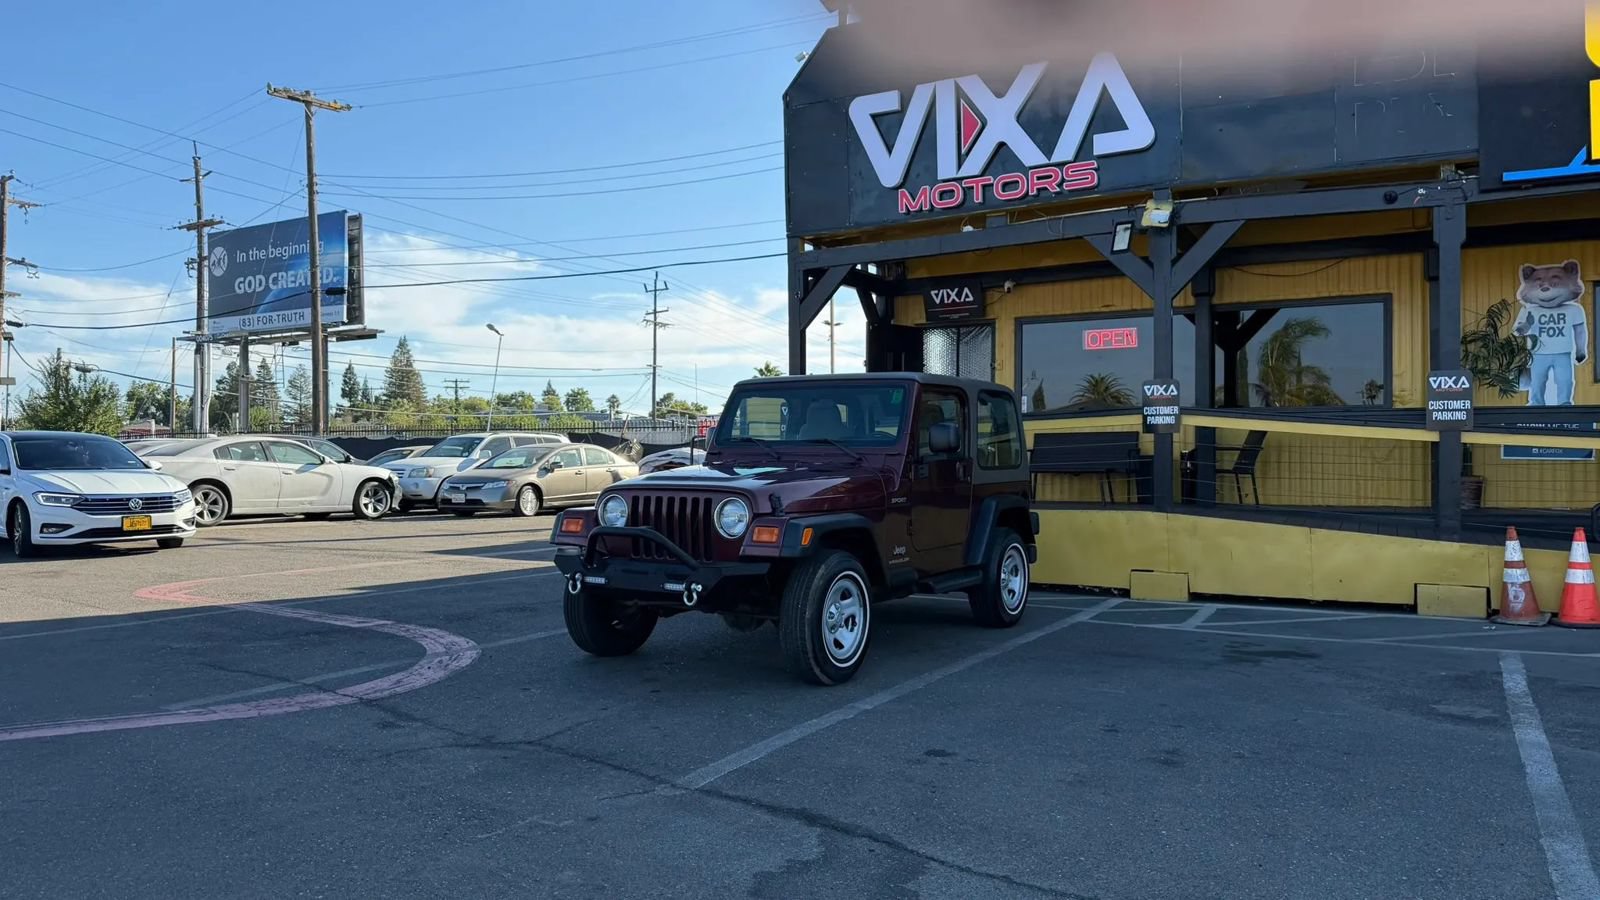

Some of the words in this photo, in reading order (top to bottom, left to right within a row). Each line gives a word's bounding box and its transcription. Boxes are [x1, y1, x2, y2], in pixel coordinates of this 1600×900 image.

[849, 51, 1155, 188] VIXA
[898, 160, 1098, 214] MOTORS
[237, 250, 246, 262] In
[249, 247, 266, 260] the
[268, 240, 324, 259] beginnig
[235, 274, 266, 294] GOD
[930, 287, 974, 304] VIXA
[239, 317, 254, 328] (83)
[257, 311, 305, 326] FOR-TRUTH
[1538, 313, 1566, 325] CAR
[1088, 329, 1136, 347] OPEN
[1538, 326, 1565, 337] FOX
[1429, 376, 1470, 389] VIXA
[1143, 384, 1178, 396] VIXA
[1143, 406, 1179, 415] CUSTOMER
[1429, 400, 1471, 410] CUSTOMER
[1147, 416, 1175, 424] PARKING
[1432, 411, 1467, 421] PARKING
